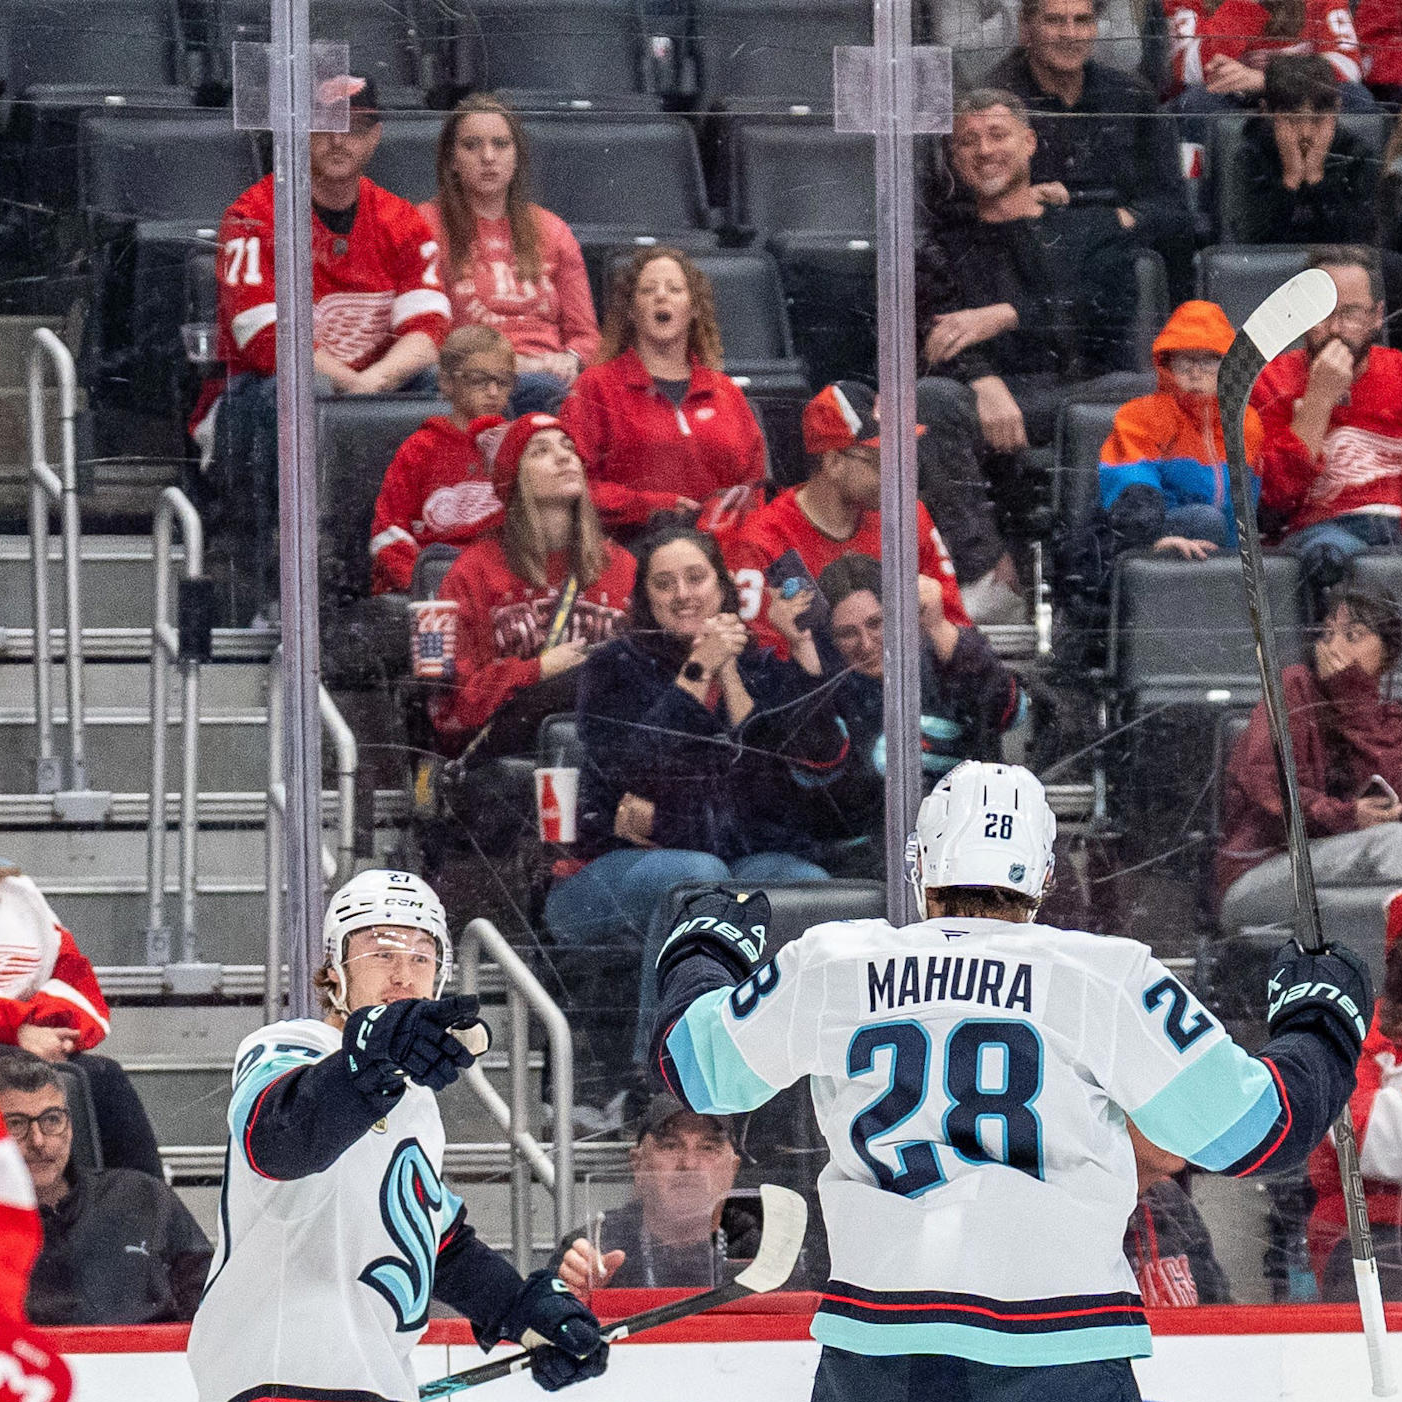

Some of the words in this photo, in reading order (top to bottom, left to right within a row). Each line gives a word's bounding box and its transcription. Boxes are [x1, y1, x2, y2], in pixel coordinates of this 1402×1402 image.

[224, 236, 262, 285] 71
[984, 812, 1014, 840] 28
[384, 898, 424, 909] CCM
[867, 955, 1033, 1014] MAHURA
[1142, 975, 1215, 1054] 2
[845, 1017, 1046, 1200] 28
